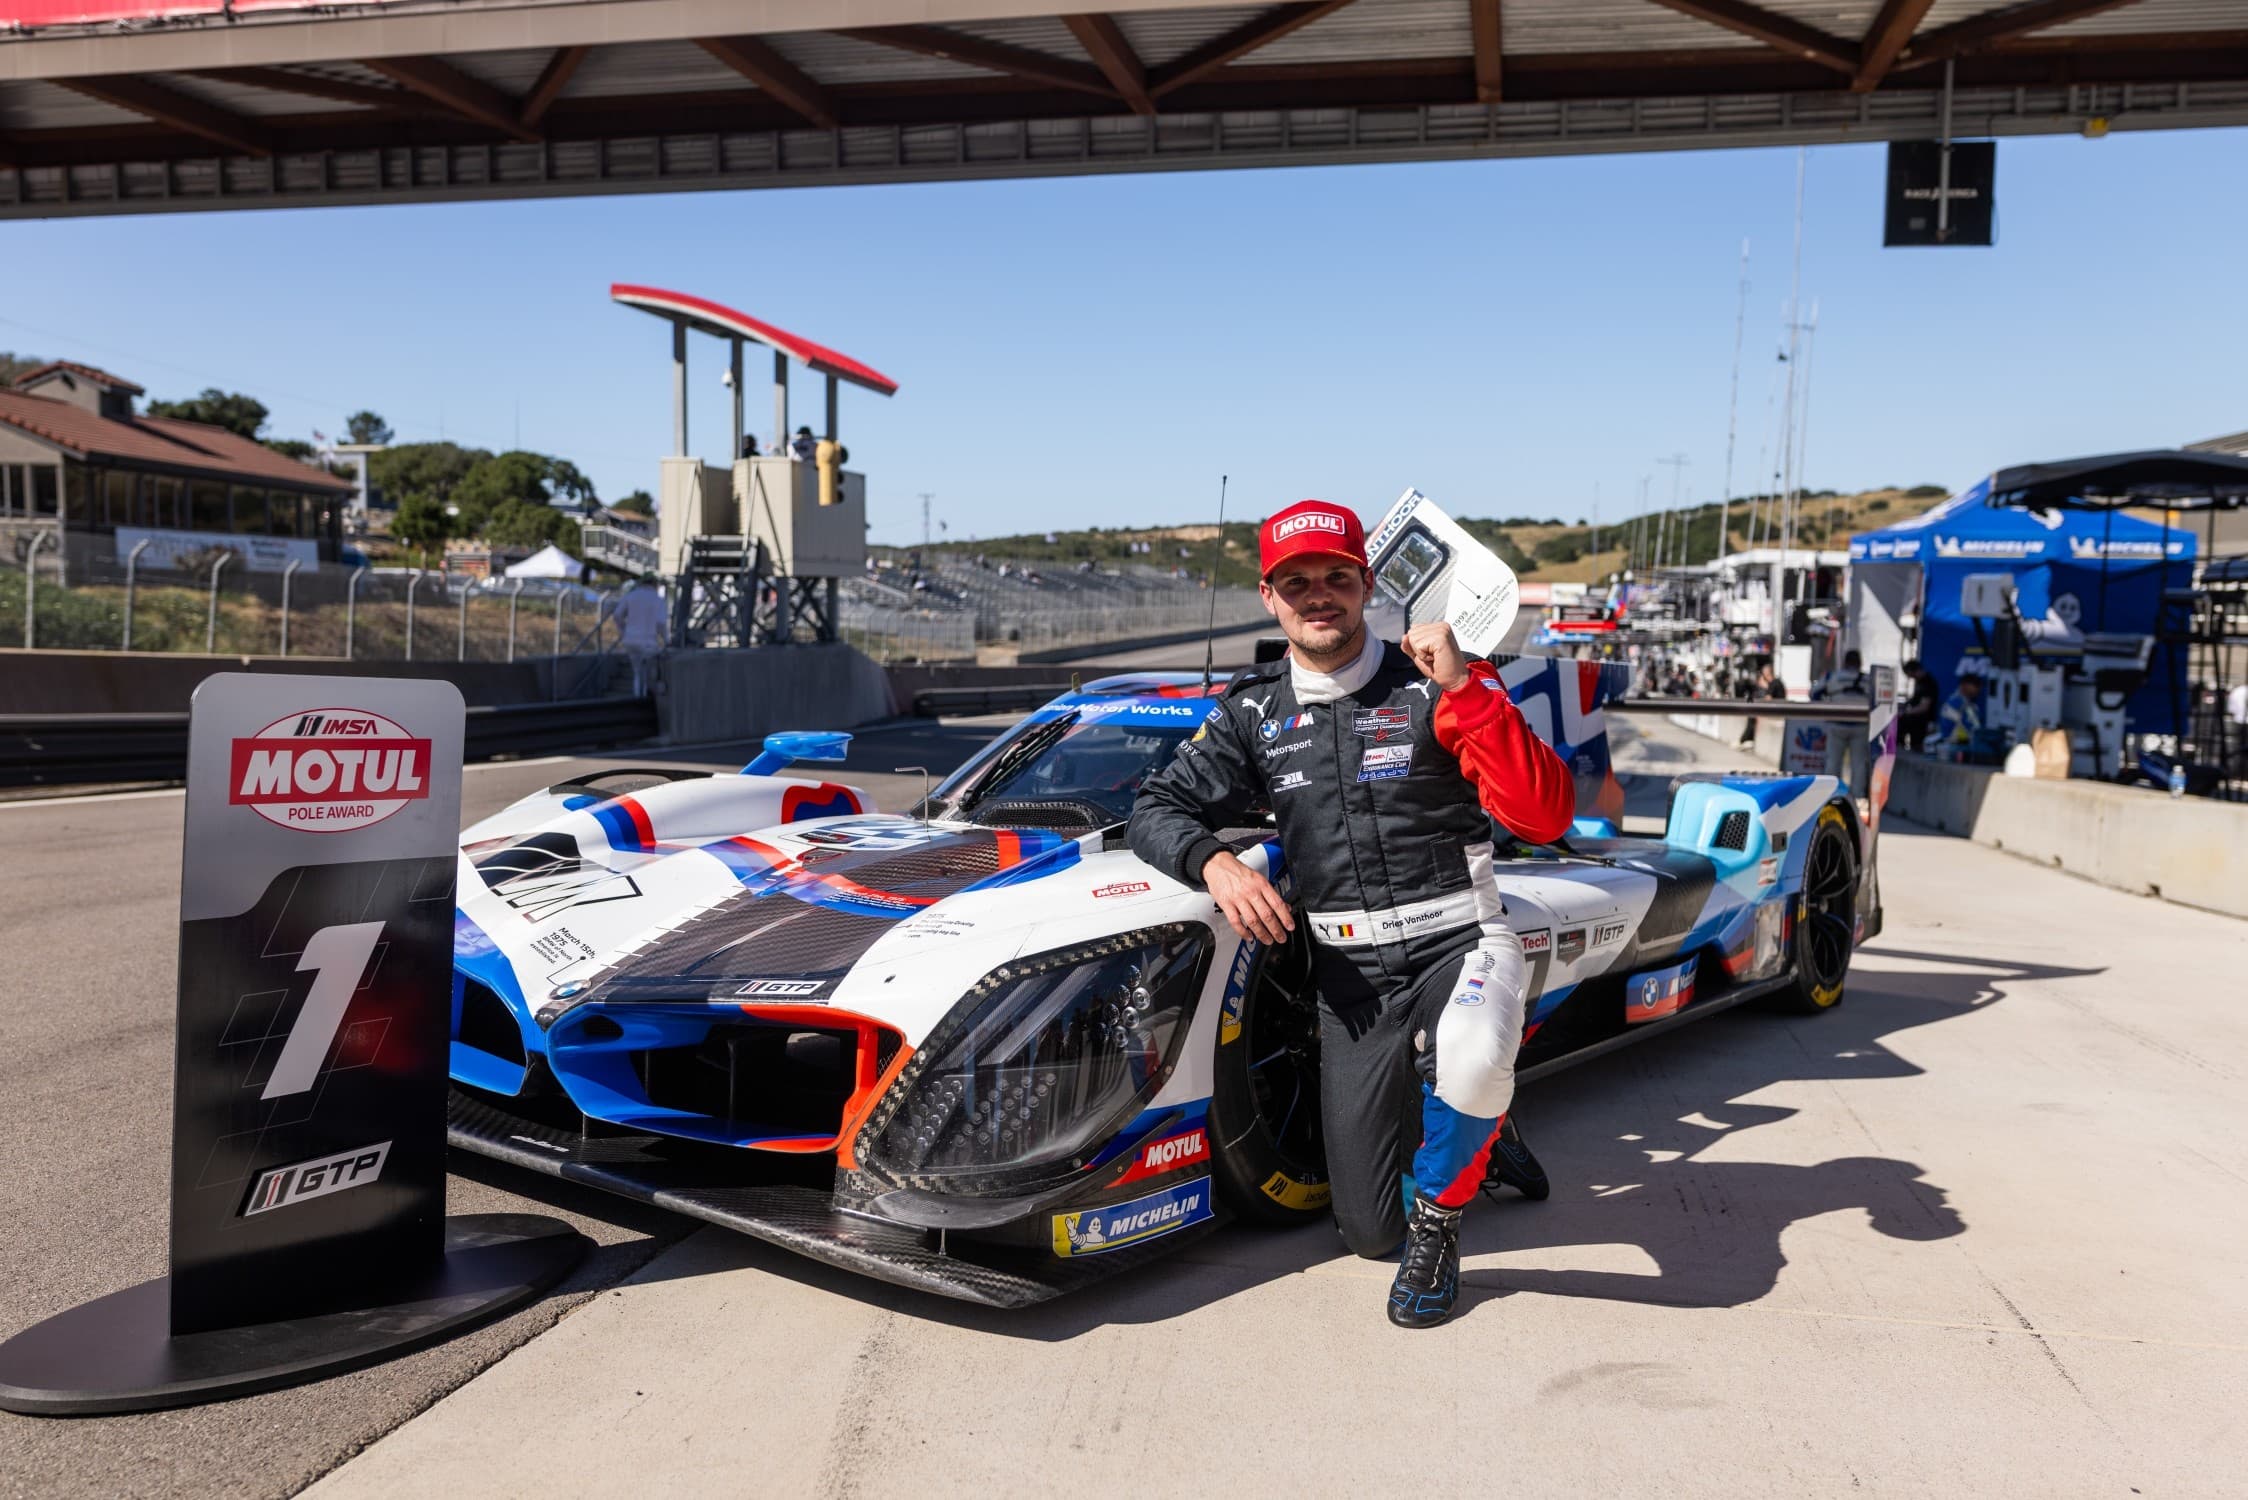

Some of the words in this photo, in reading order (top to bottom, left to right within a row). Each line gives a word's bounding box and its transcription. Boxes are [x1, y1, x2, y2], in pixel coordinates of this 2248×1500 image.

[1279, 515, 1340, 538] MOTUL
[1367, 494, 1422, 563] ANTHOOR
[1451, 610, 1469, 628] 1999
[1074, 703, 1128, 713] Motor
[1131, 705, 1193, 716] Works
[322, 719, 379, 735] IMSA
[1265, 739, 1313, 759] Motorsport
[239, 749, 422, 796] MOTUL
[288, 806, 325, 820] POLE
[326, 804, 375, 819] AWARD
[1096, 882, 1148, 897] MOTUL
[1381, 919, 1404, 930] Dries
[1404, 910, 1444, 925] Vanthoor
[549, 932, 568, 947] 1975
[559, 927, 581, 946] March
[1604, 924, 1625, 941] GTP
[763, 983, 817, 992] GTP
[260, 920, 387, 1101] 1
[1144, 1133, 1203, 1169] MOTUL
[294, 1150, 382, 1196] GTP
[1108, 1194, 1201, 1238] MICHELIN
